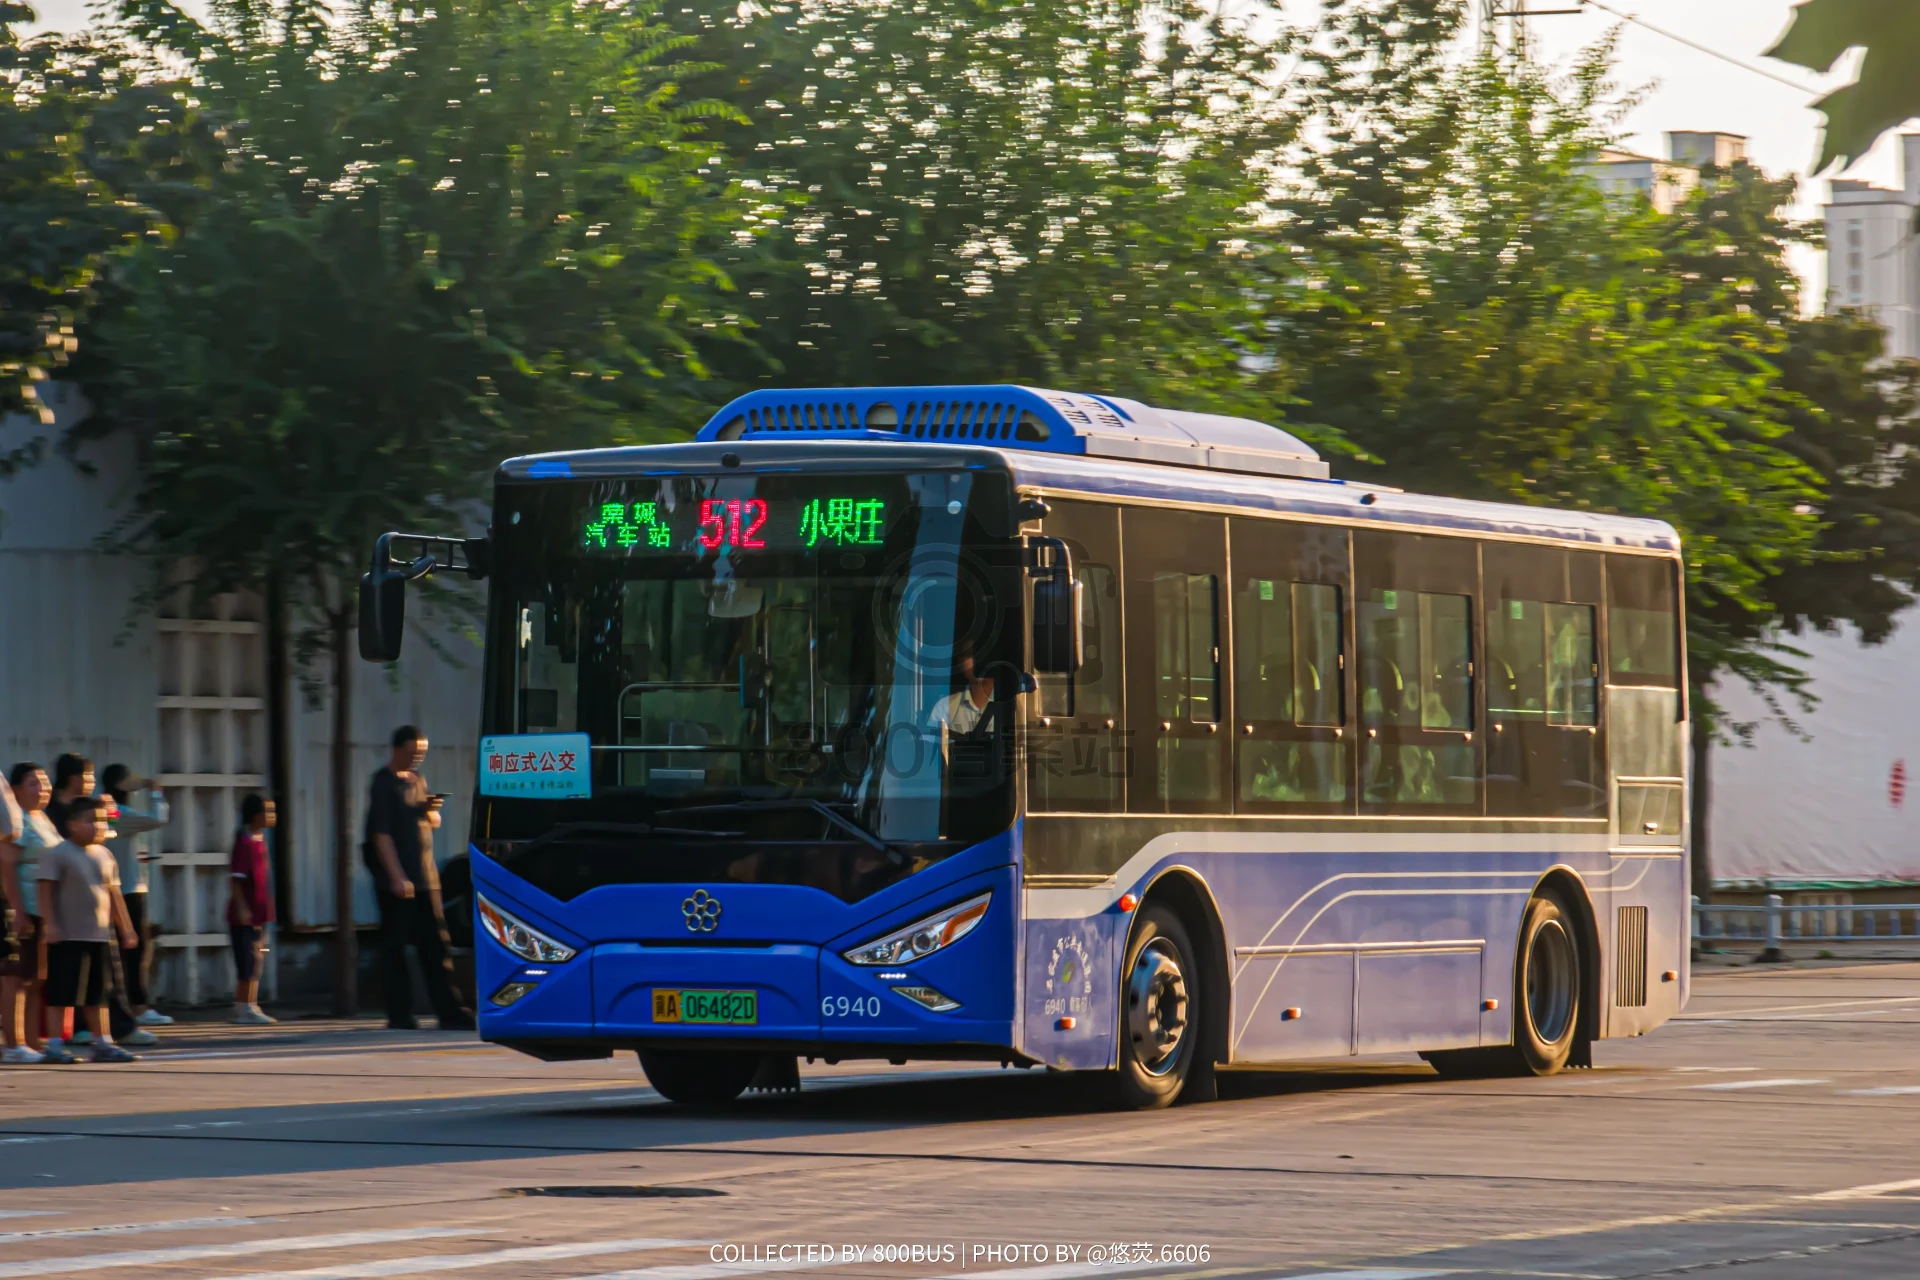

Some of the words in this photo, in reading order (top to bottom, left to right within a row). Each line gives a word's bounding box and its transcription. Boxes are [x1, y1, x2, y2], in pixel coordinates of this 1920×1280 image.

[585, 521, 671, 547] 汽车站
[701, 499, 767, 548] 512
[799, 498, 884, 546] 小果庄
[489, 750, 576, 773] 响应式公交
[821, 996, 881, 1017] 6940
